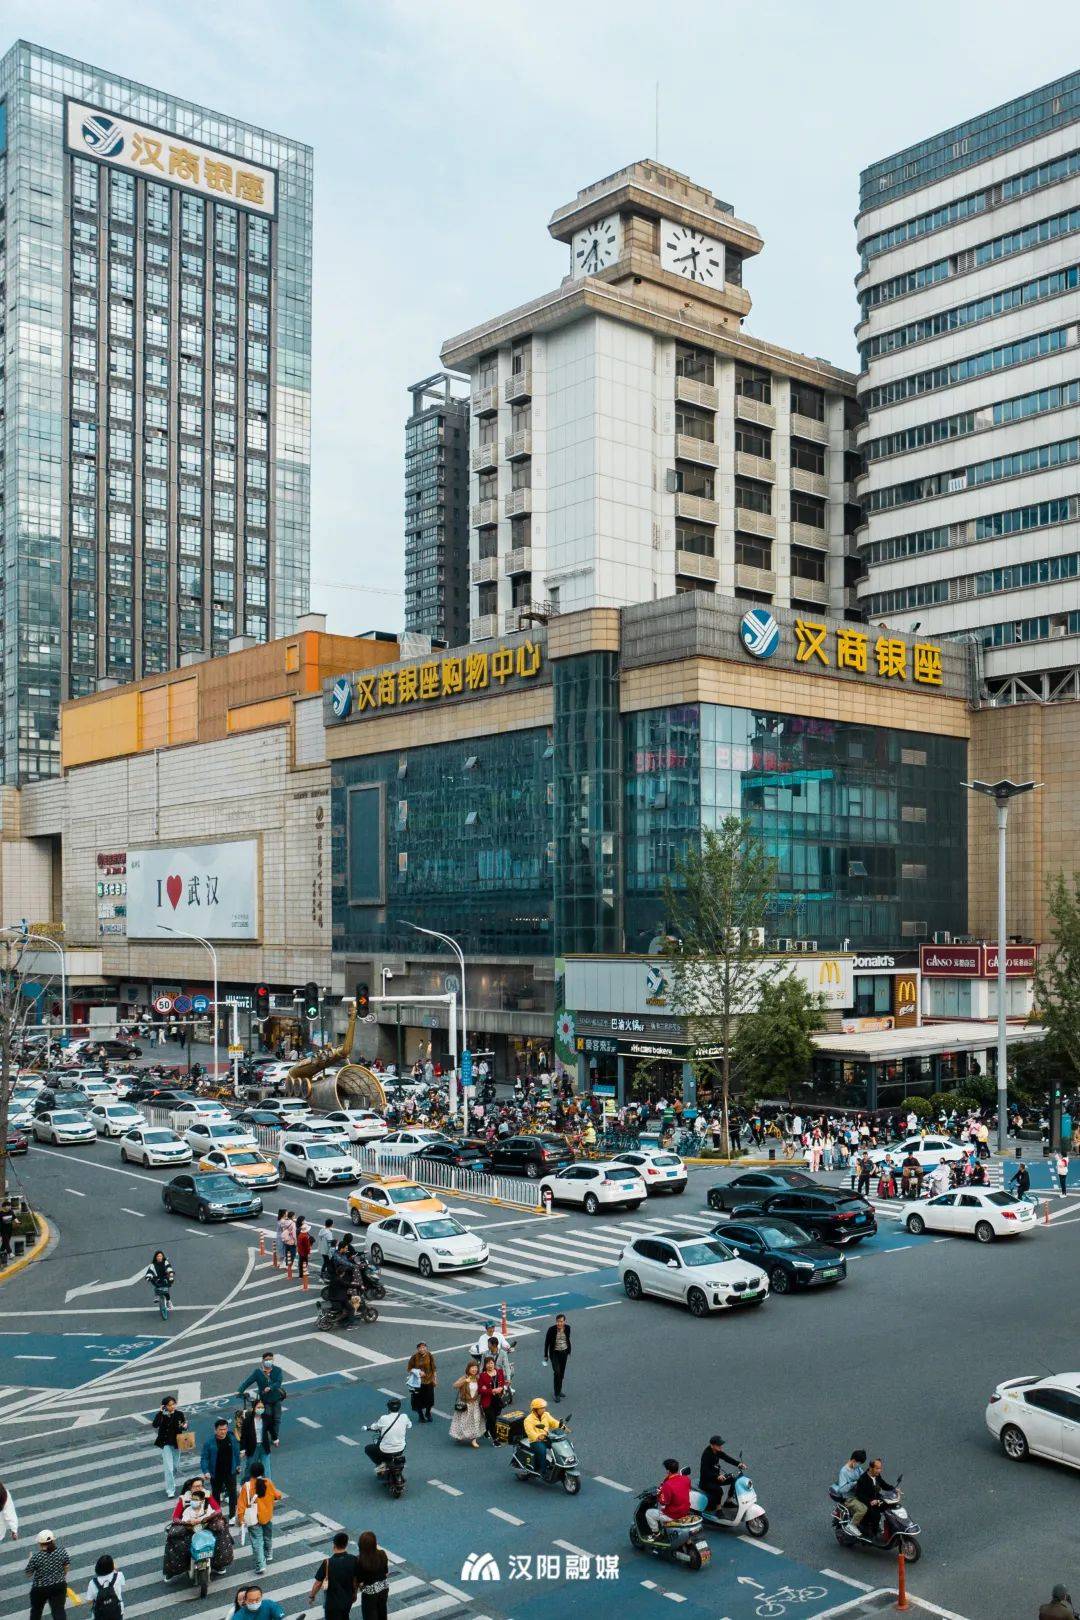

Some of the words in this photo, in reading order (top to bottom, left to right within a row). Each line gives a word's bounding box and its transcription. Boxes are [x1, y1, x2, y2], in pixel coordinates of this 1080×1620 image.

[131, 131, 266, 205] 汉商银座
[357, 639, 542, 711] 汉商银座购物中心
[794, 617, 944, 686] 汉商银座
[156, 880, 162, 907] I
[188, 875, 219, 906] 武汉
[159, 1001, 169, 1009] 50
